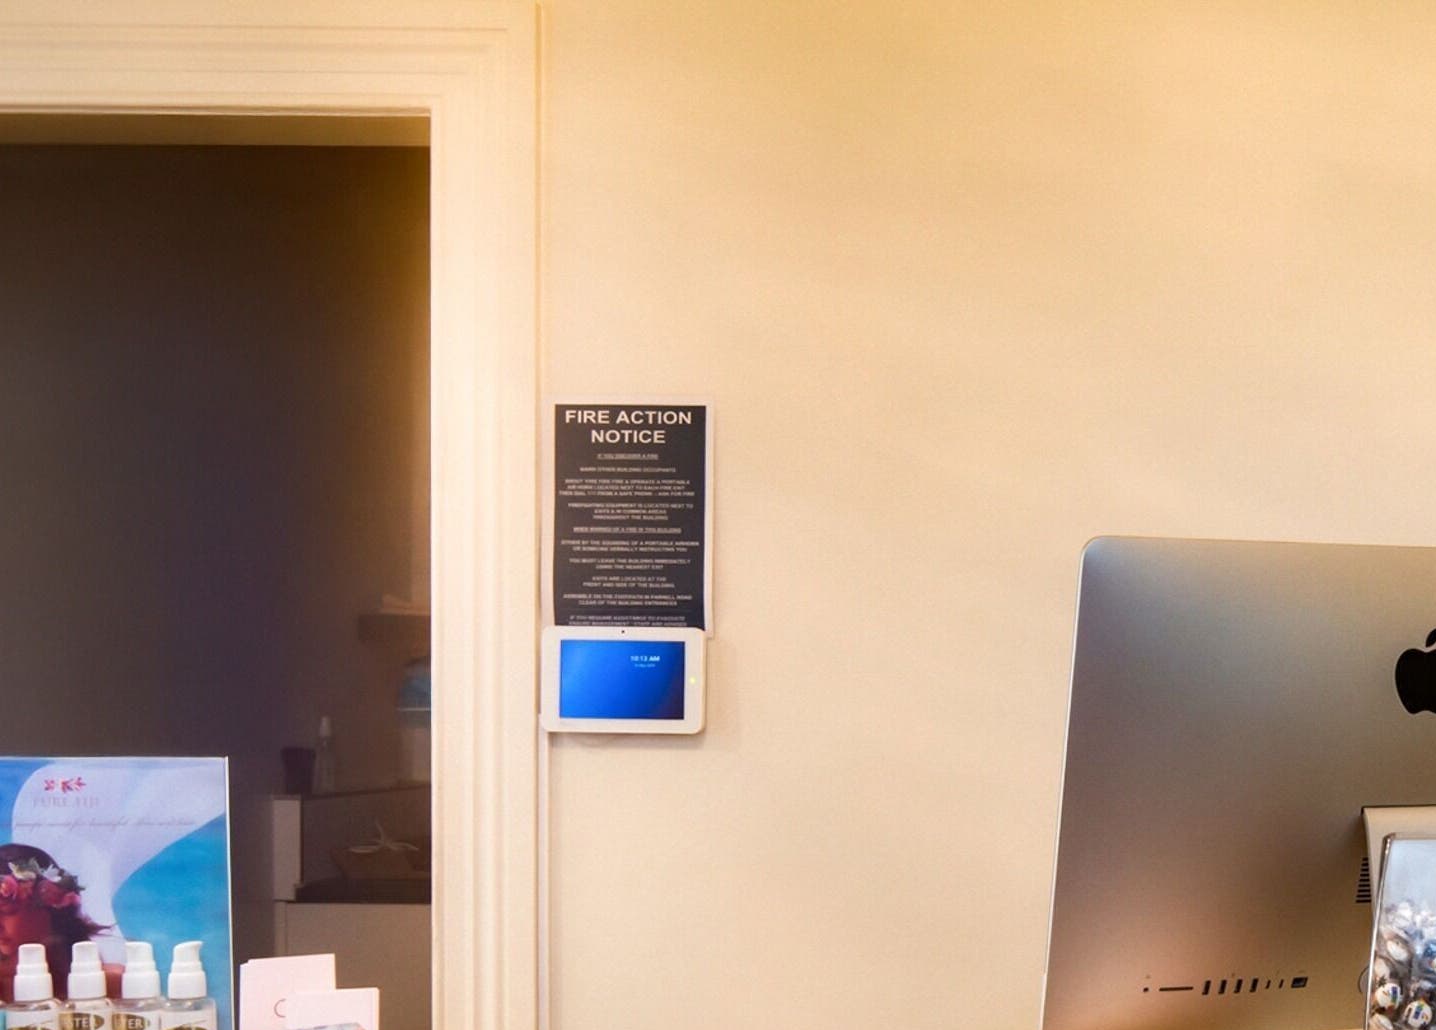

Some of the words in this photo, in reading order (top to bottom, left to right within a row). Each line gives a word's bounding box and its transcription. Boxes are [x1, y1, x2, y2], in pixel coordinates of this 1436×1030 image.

[565, 410, 610, 424] FIRE
[615, 410, 692, 425] ACTION
[591, 430, 666, 444] NOTICE
